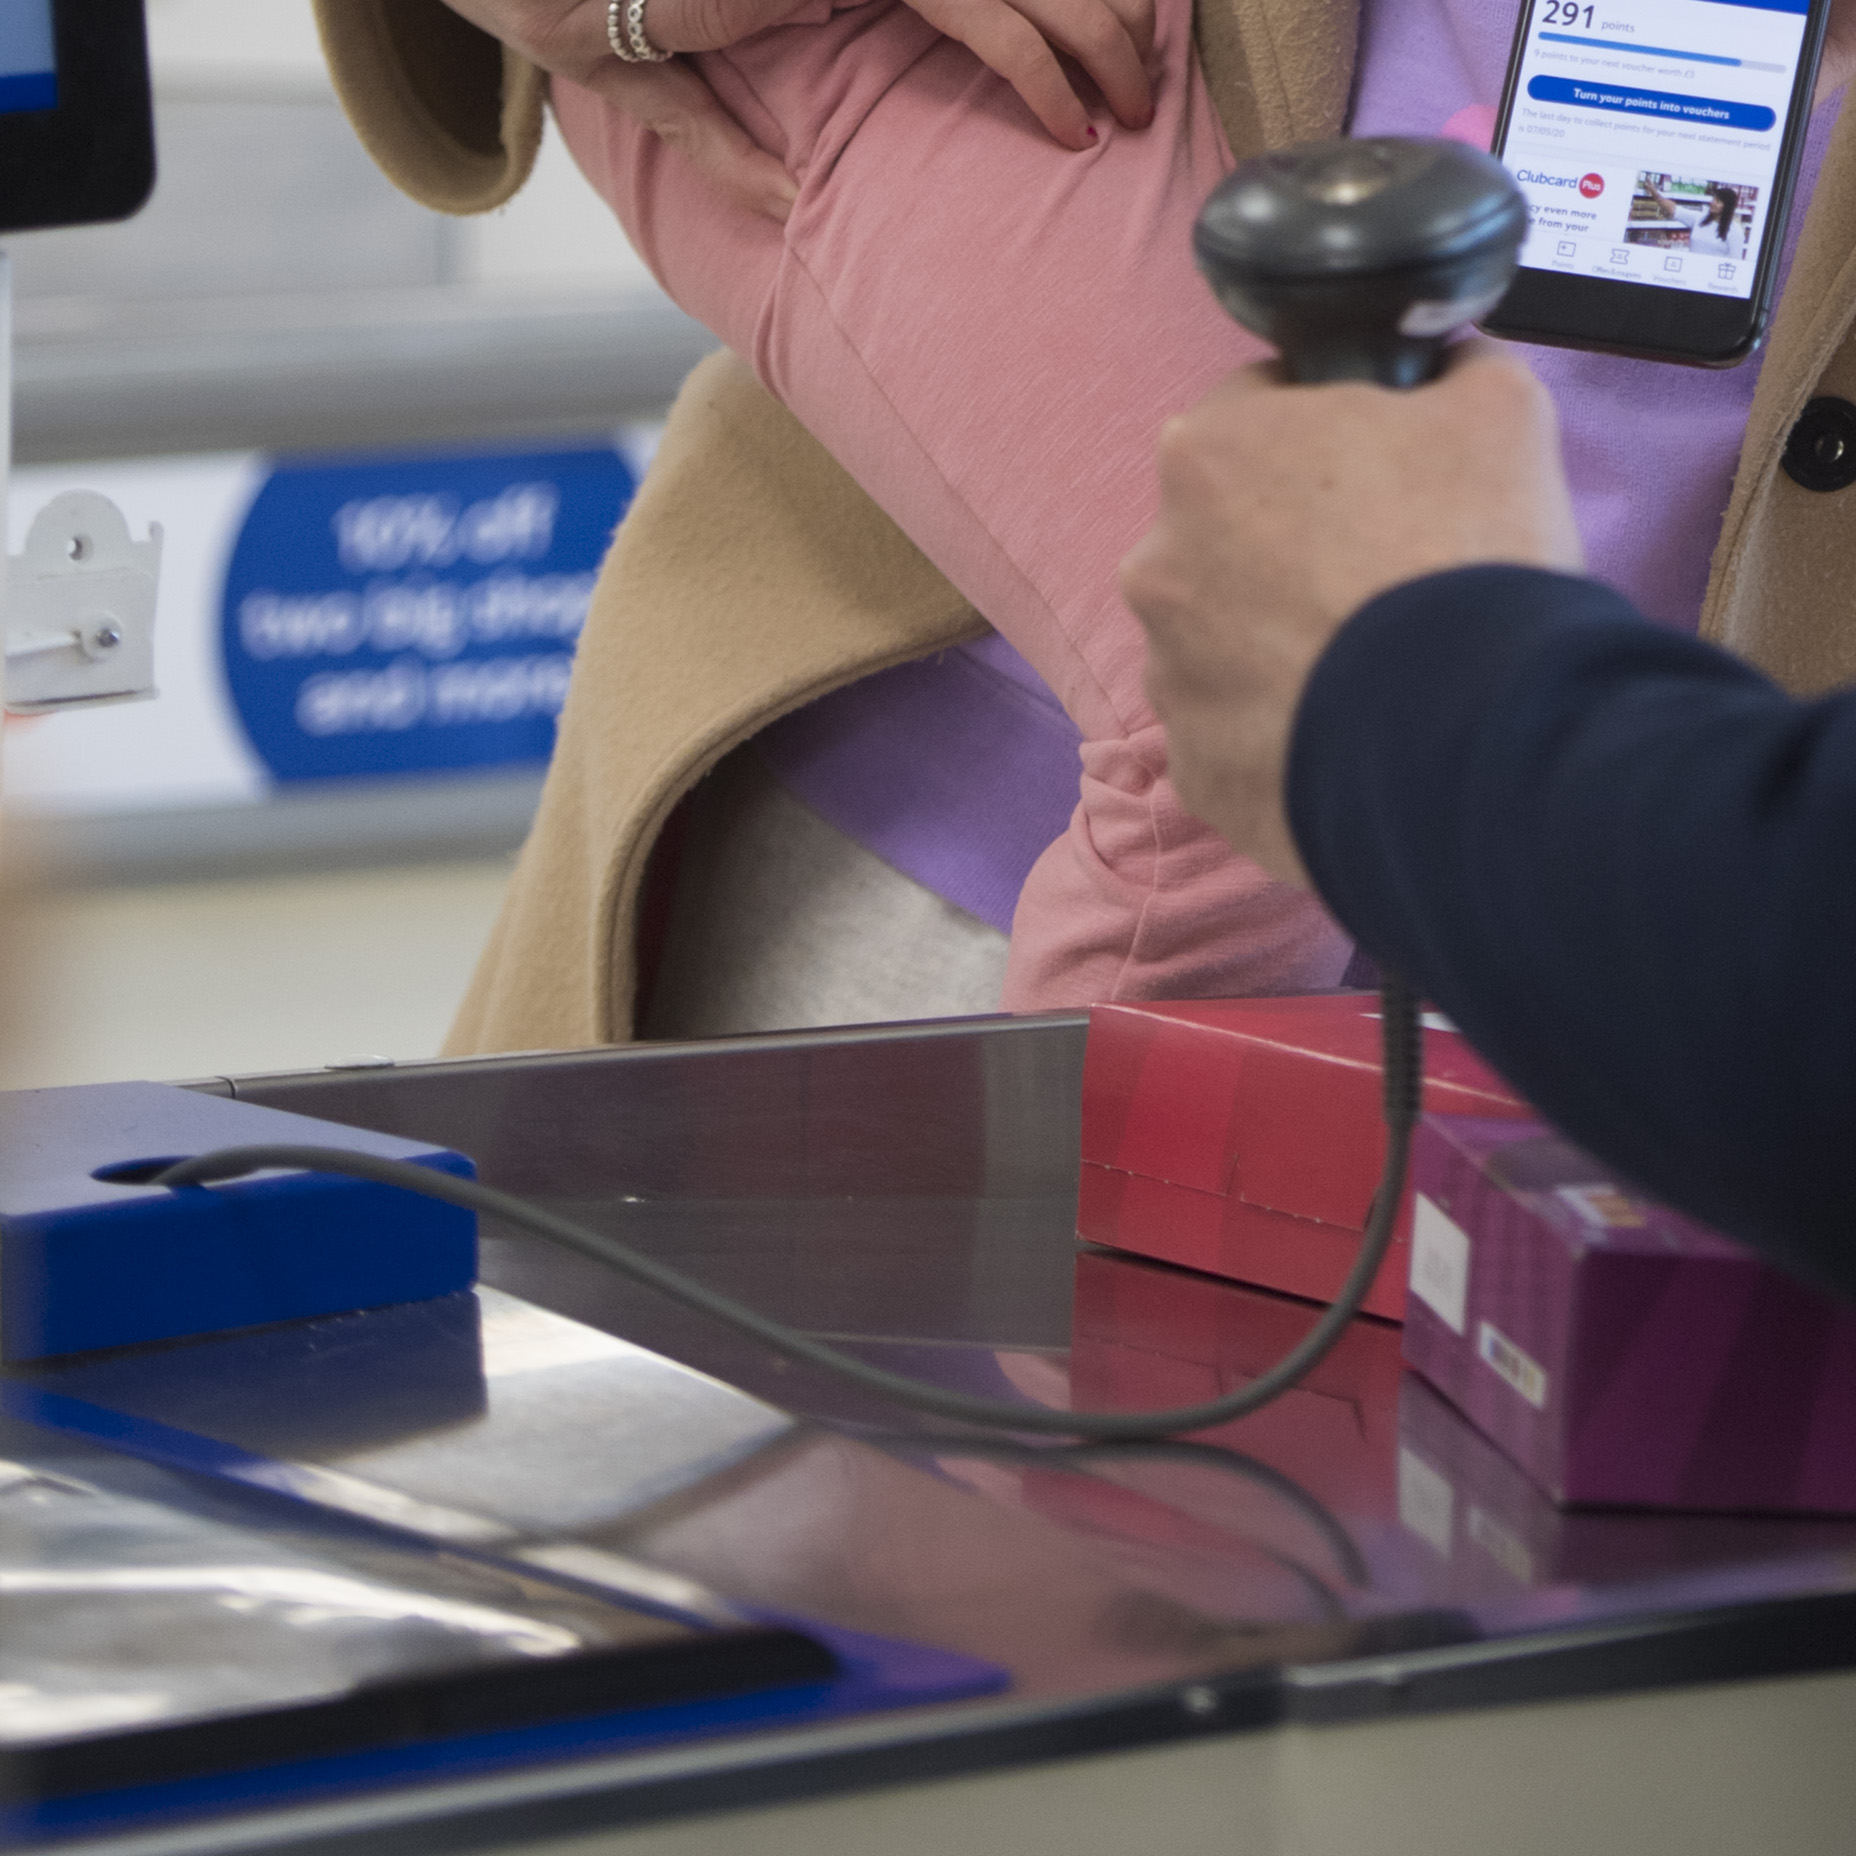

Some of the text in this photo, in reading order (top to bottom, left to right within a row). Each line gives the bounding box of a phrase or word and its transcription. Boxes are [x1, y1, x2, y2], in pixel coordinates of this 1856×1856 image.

[1542, 0, 1636, 33] 291 points
[1541, 50, 1568, 62] points
[1570, 54, 1579, 62] to
[1580, 57, 1600, 66] your
[1602, 59, 1620, 68] next
[1622, 62, 1656, 74] voucher
[1657, 67, 1682, 77] worth
[1574, 88, 1730, 120] Turn your points into vouchers
[1518, 124, 1524, 132] is
[1522, 108, 1771, 151] The last day to collect points for your next statement period
[1517, 170, 1601, 191] Clubcard Plus
[1539, 218, 1562, 228] from
[1566, 222, 1588, 232] your
[1544, 207, 1568, 216] even
[1571, 212, 1597, 220] more
